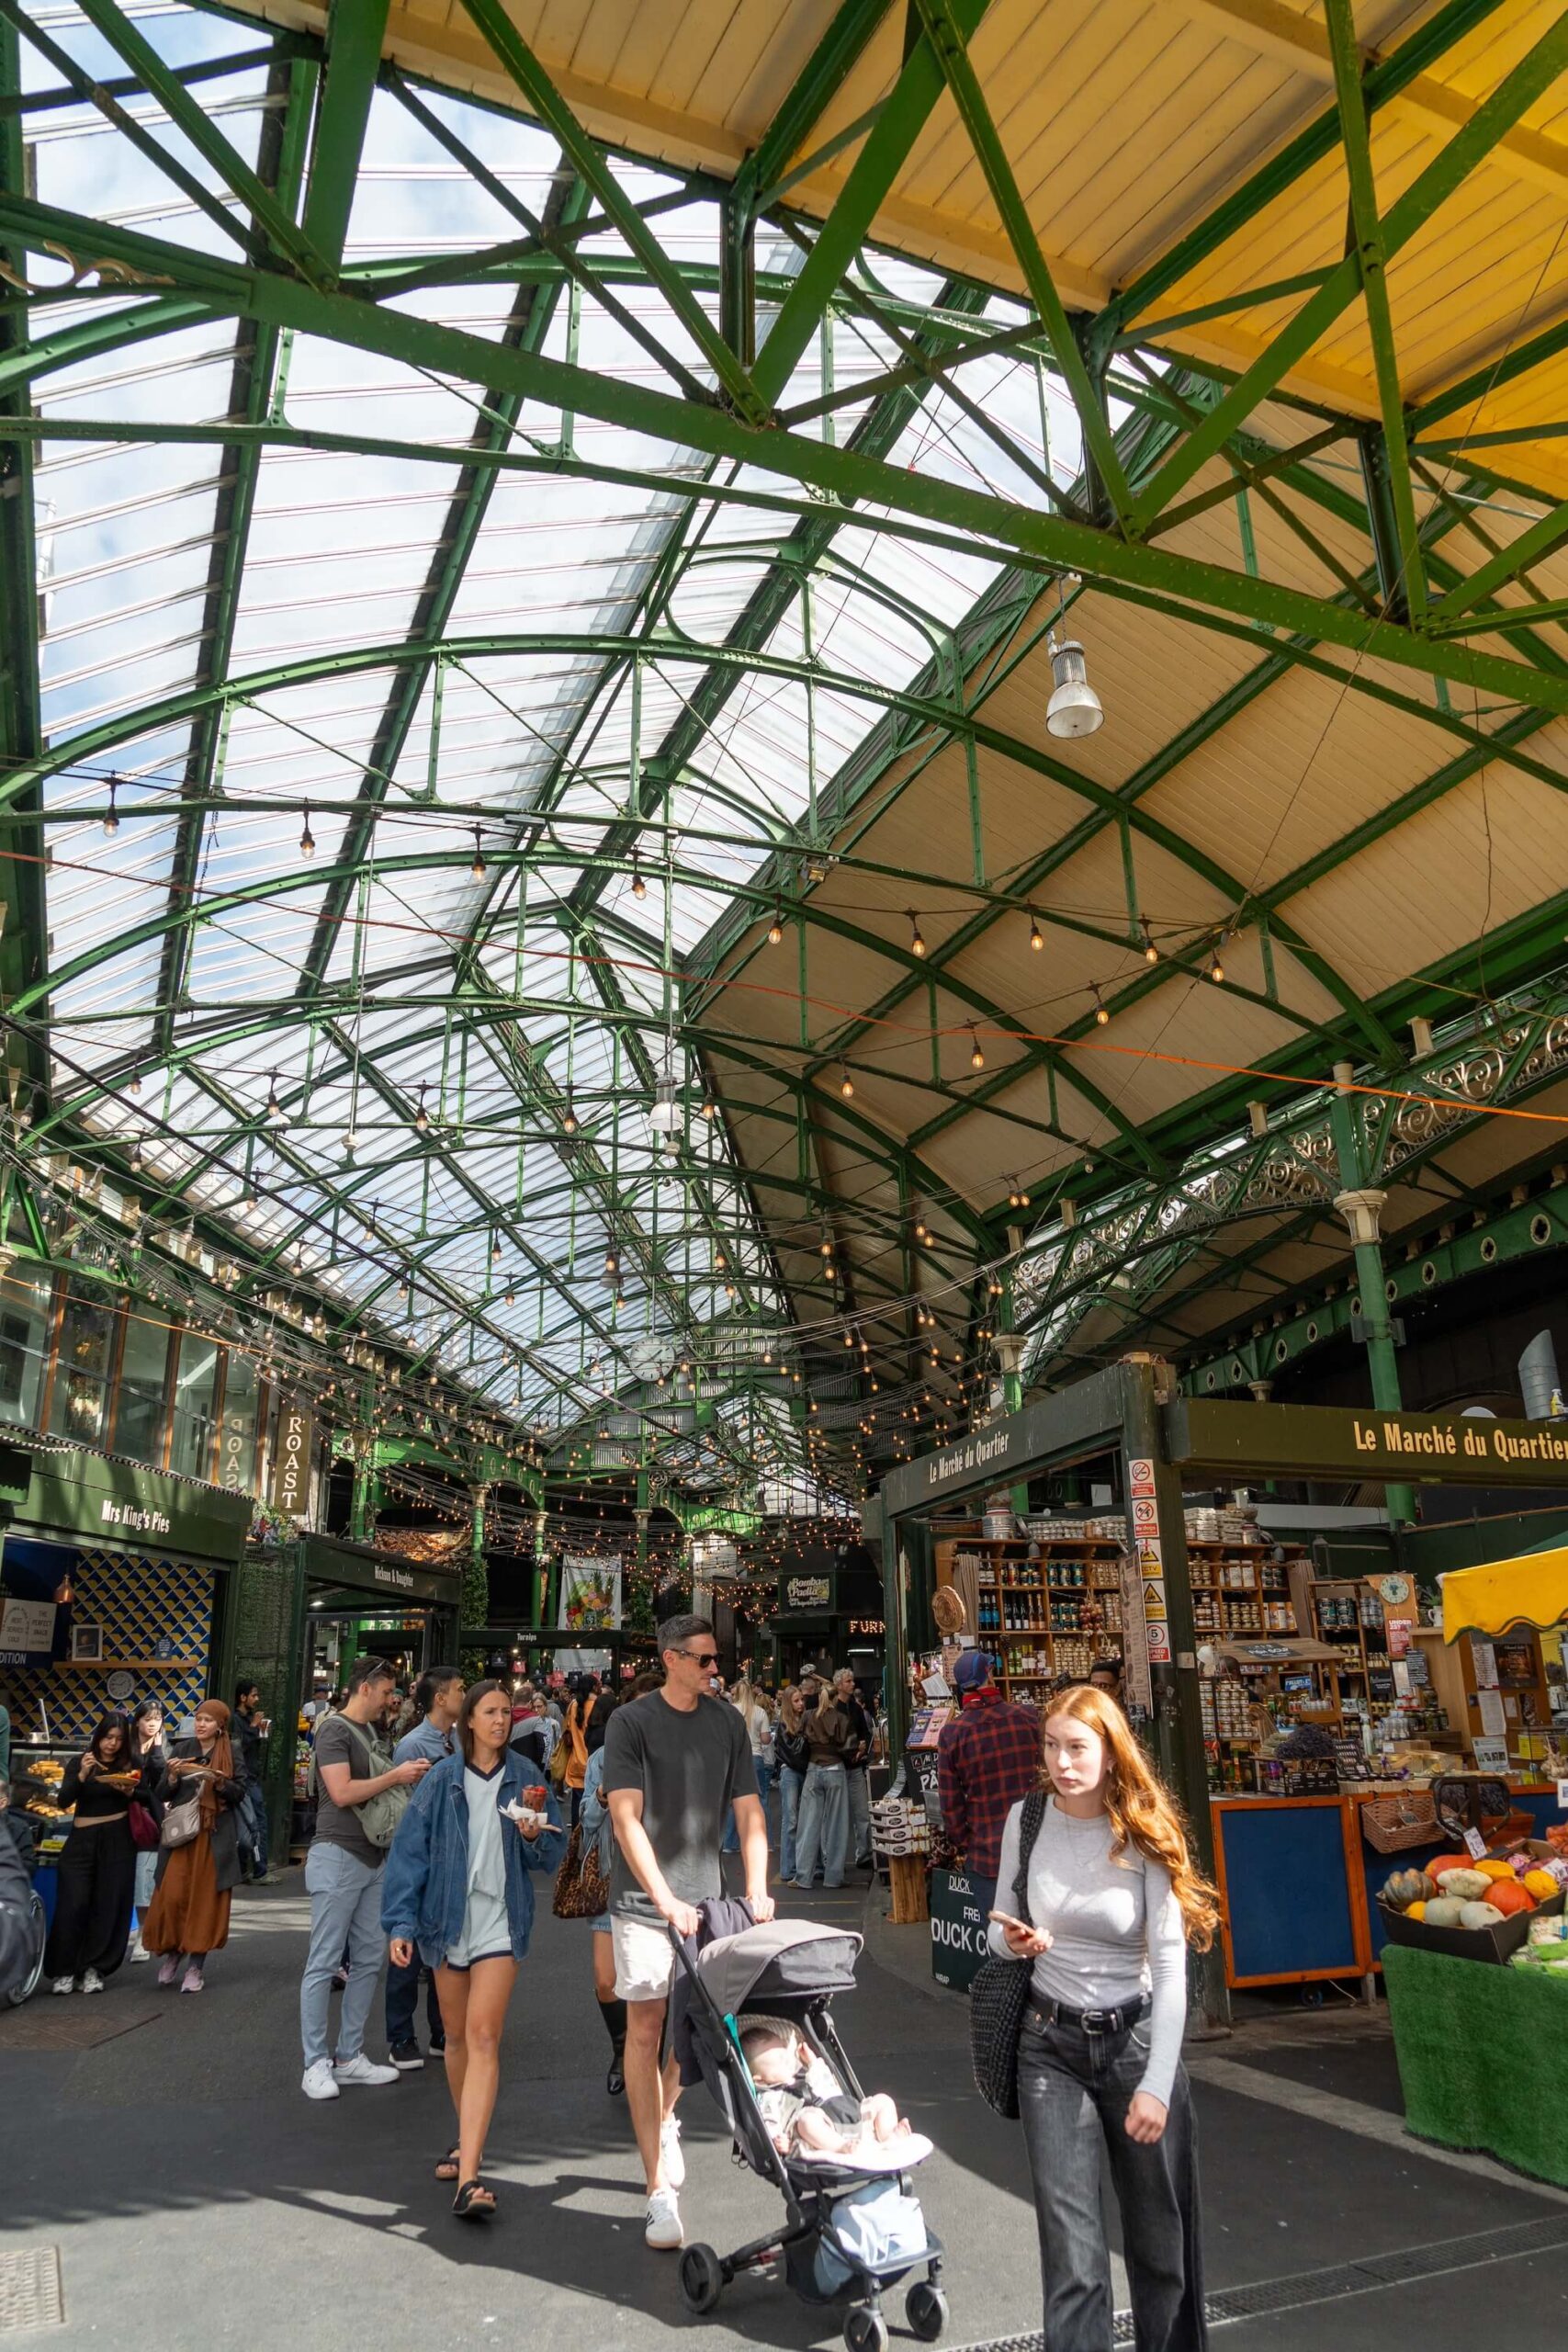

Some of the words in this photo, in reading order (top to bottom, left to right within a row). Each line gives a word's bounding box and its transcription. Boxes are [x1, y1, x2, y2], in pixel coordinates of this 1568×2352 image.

[1353, 1421, 1377, 1451] Le
[1383, 1422, 1457, 1454] Marché
[1463, 1428, 1488, 1457] du
[1494, 1429, 1568, 1463] Quartier
[281, 1417, 302, 1509] ROAST
[930, 1462, 937, 1484] Le
[939, 1448, 964, 1480] Marché
[964, 1444, 974, 1469] du
[976, 1430, 1009, 1467] Quartier
[101, 1499, 120, 1523] Mrs
[122, 1504, 150, 1531] King's
[152, 1510, 170, 1533] Pies
[792, 1577, 821, 1588] Bomba
[850, 1621, 886, 1633] FURN
[1151, 1629, 1158, 1638] 5
[516, 1633, 537, 1642] Turnips
[949, 1875, 970, 1893] DUCK
[963, 1905, 981, 1922] FRE
[931, 1917, 973, 1952] DUCK
[935, 1973, 950, 1984] WRAP
